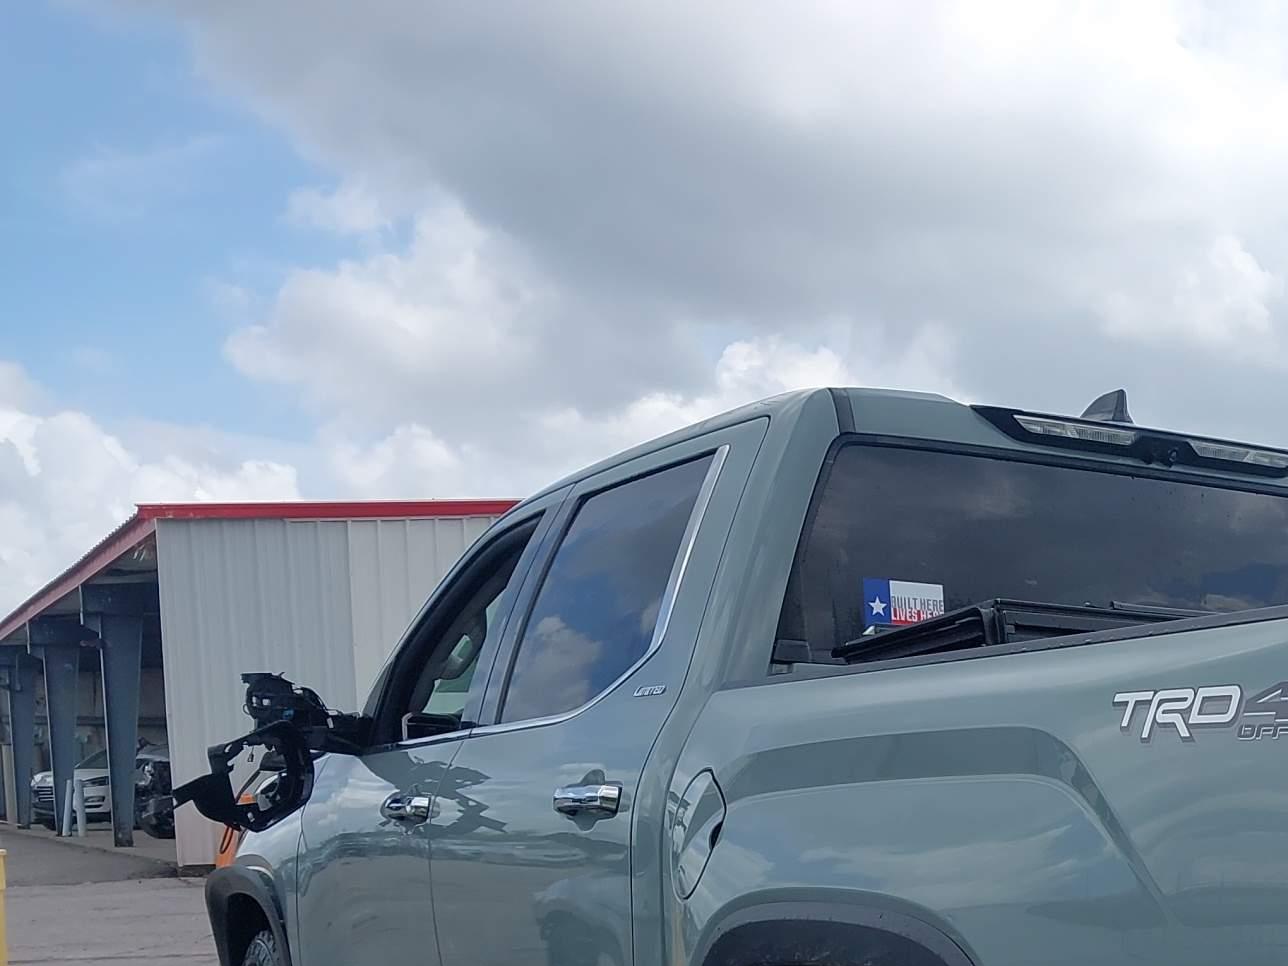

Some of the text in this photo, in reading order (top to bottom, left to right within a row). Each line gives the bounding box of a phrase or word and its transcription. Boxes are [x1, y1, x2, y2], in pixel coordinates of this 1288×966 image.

[891, 596, 944, 612] BUILT HERE
[891, 607, 945, 622] LIVES HER
[1112, 685, 1242, 742] TRD
